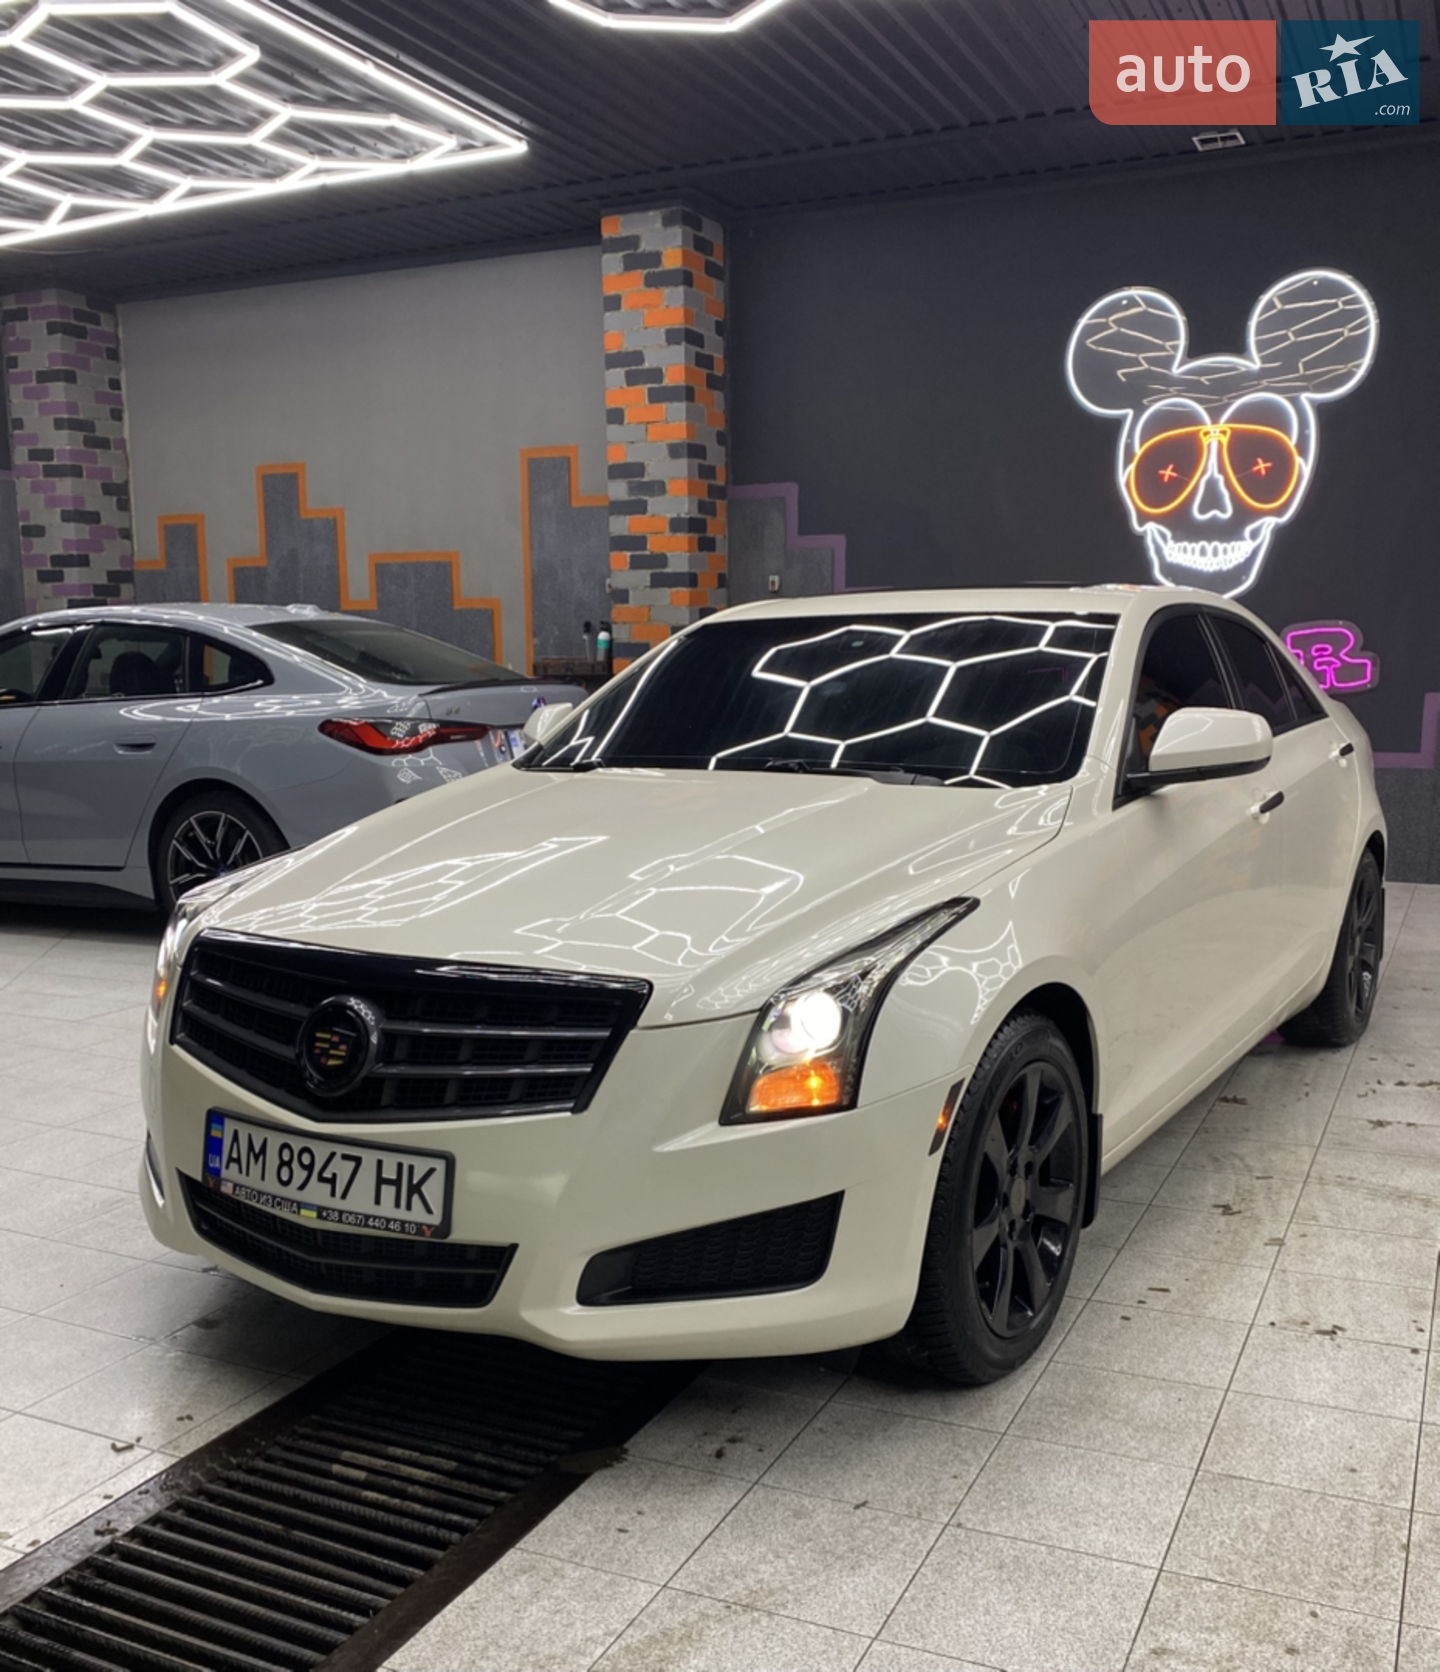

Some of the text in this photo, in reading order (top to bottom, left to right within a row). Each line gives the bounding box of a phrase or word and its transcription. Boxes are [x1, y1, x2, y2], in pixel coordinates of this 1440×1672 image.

[208, 1153, 220, 1168] UA
[225, 1129, 437, 1215] AM 8947 HK
[234, 1186, 298, 1214] АВТО ИЗ США
[321, 1210, 417, 1235] +38 (067) 440 46 10
